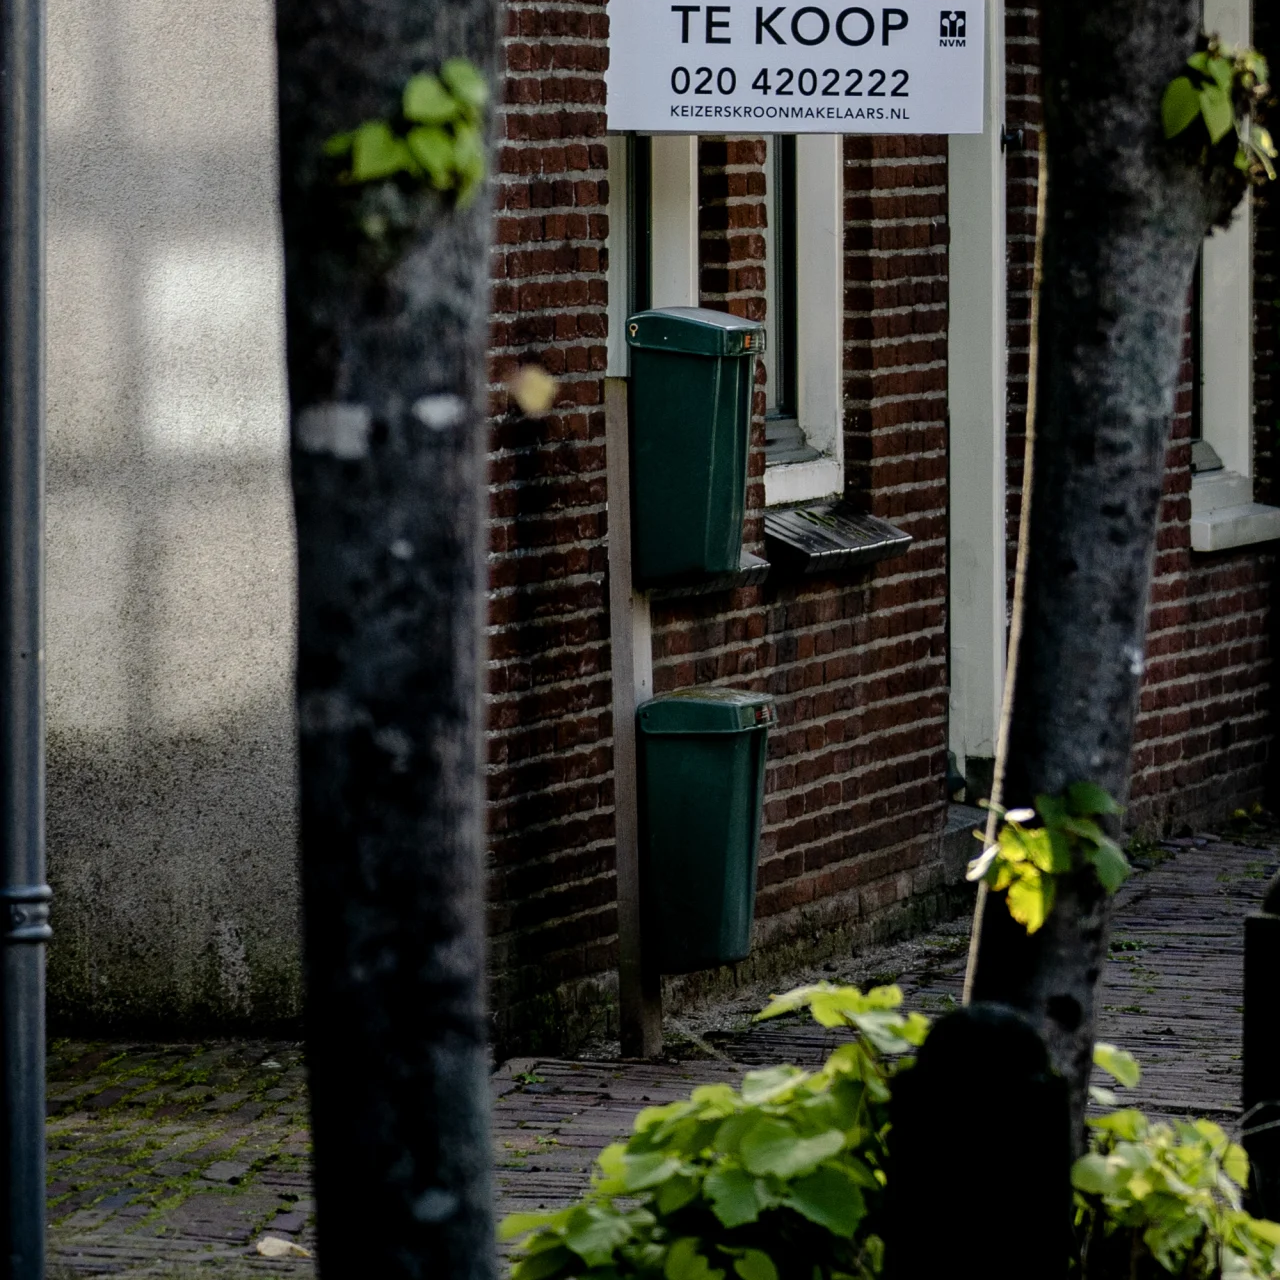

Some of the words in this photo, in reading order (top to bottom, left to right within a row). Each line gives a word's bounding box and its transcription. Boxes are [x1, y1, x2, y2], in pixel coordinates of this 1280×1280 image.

[672, 5, 731, 44] TE
[755, 6, 909, 46] KOOP
[939, 39, 966, 47] NVM
[671, 67, 736, 95] 020
[752, 68, 910, 97] 4202222
[670, 105, 910, 120] KEIZERSKROONMAKELAARS.NL
